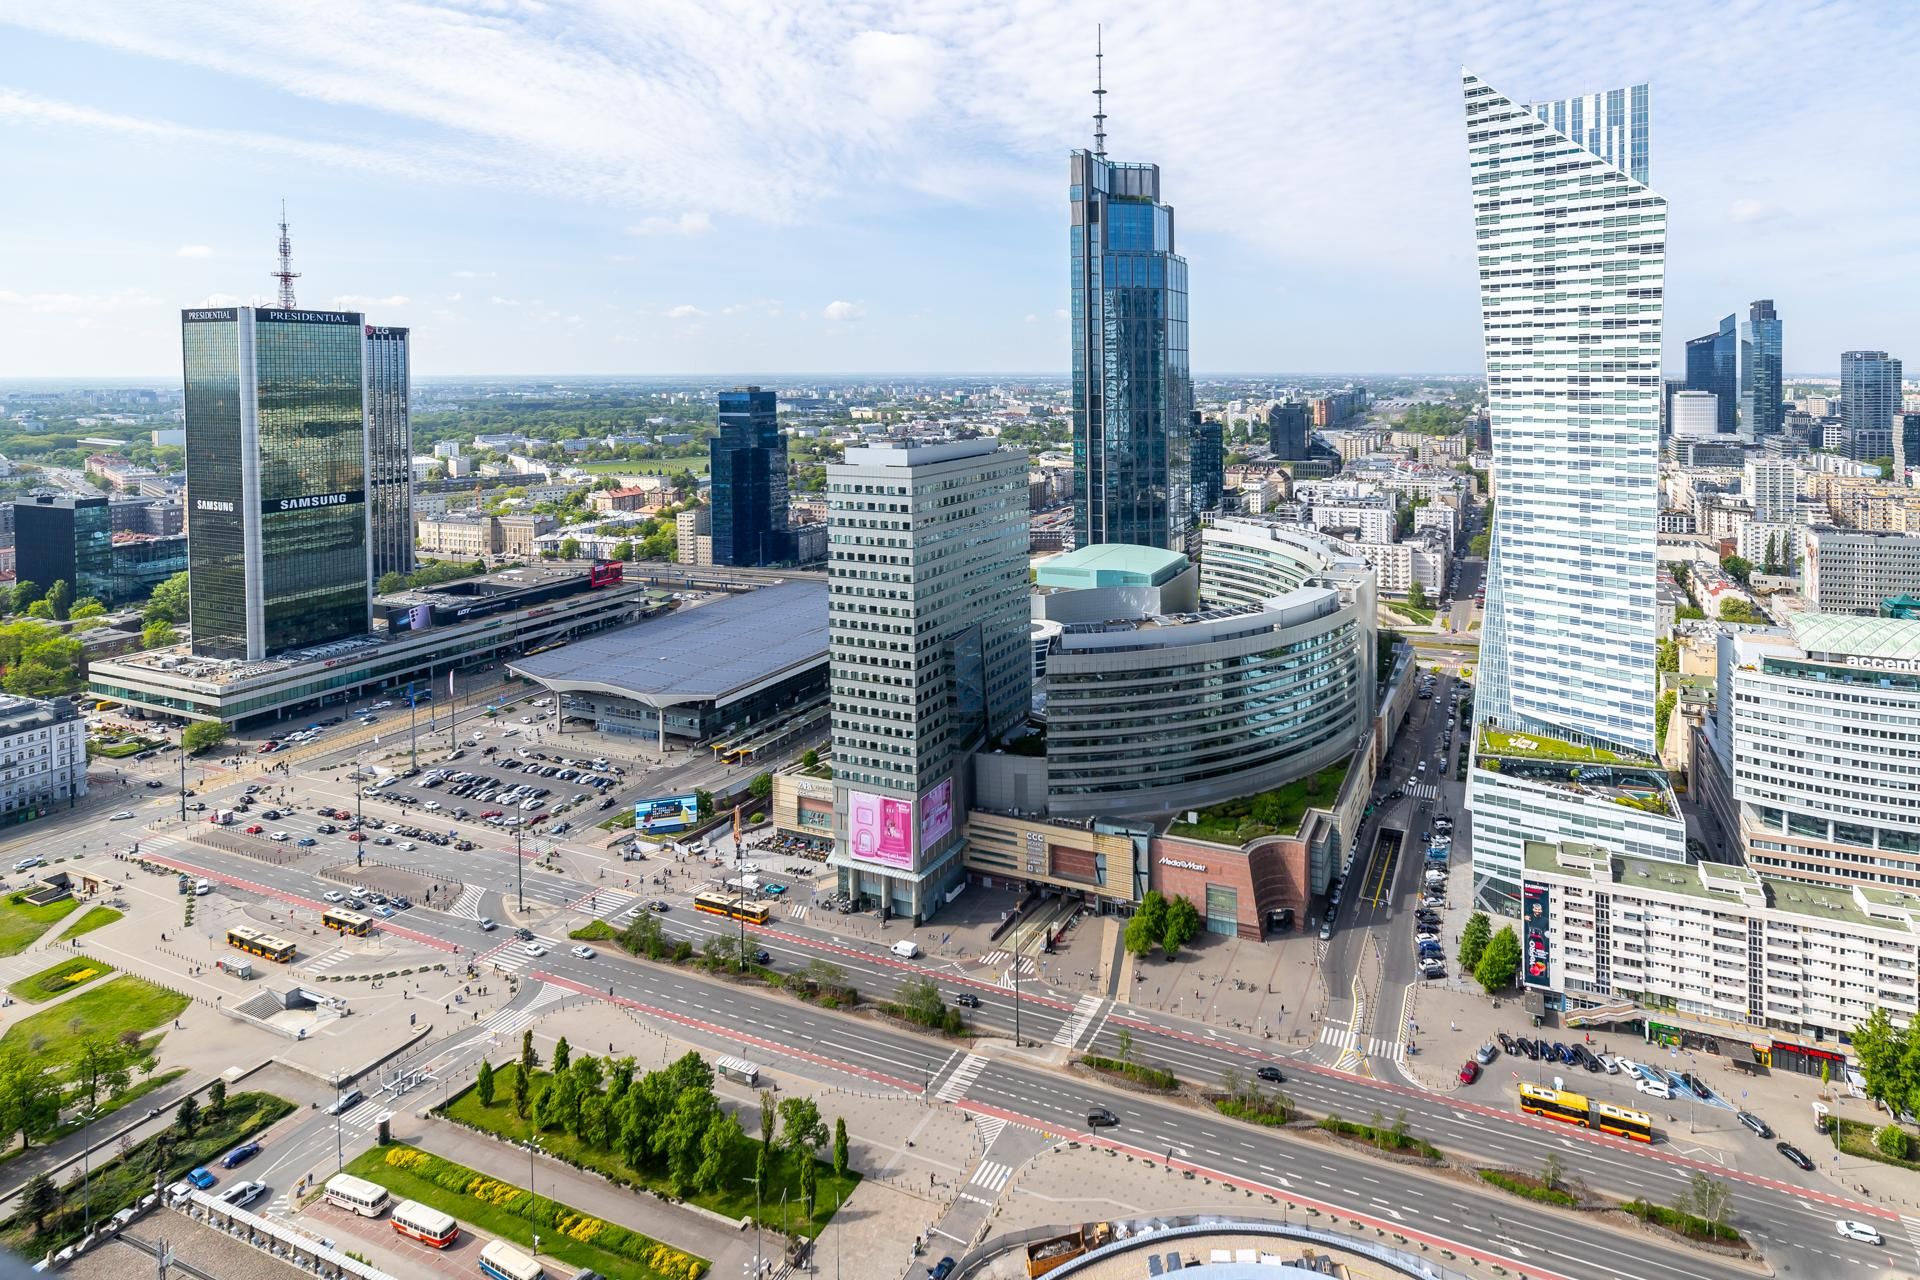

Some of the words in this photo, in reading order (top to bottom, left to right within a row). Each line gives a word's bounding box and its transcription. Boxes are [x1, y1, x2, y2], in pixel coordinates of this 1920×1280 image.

[188, 311, 231, 320] PRESIDENTIAL
[270, 311, 348, 323] PRESIDENTIAL
[196, 500, 234, 512] SAMSUNG
[280, 493, 347, 510] SAMSUNG
[1846, 655, 1920, 672] accent
[1026, 832, 1044, 842] CCC
